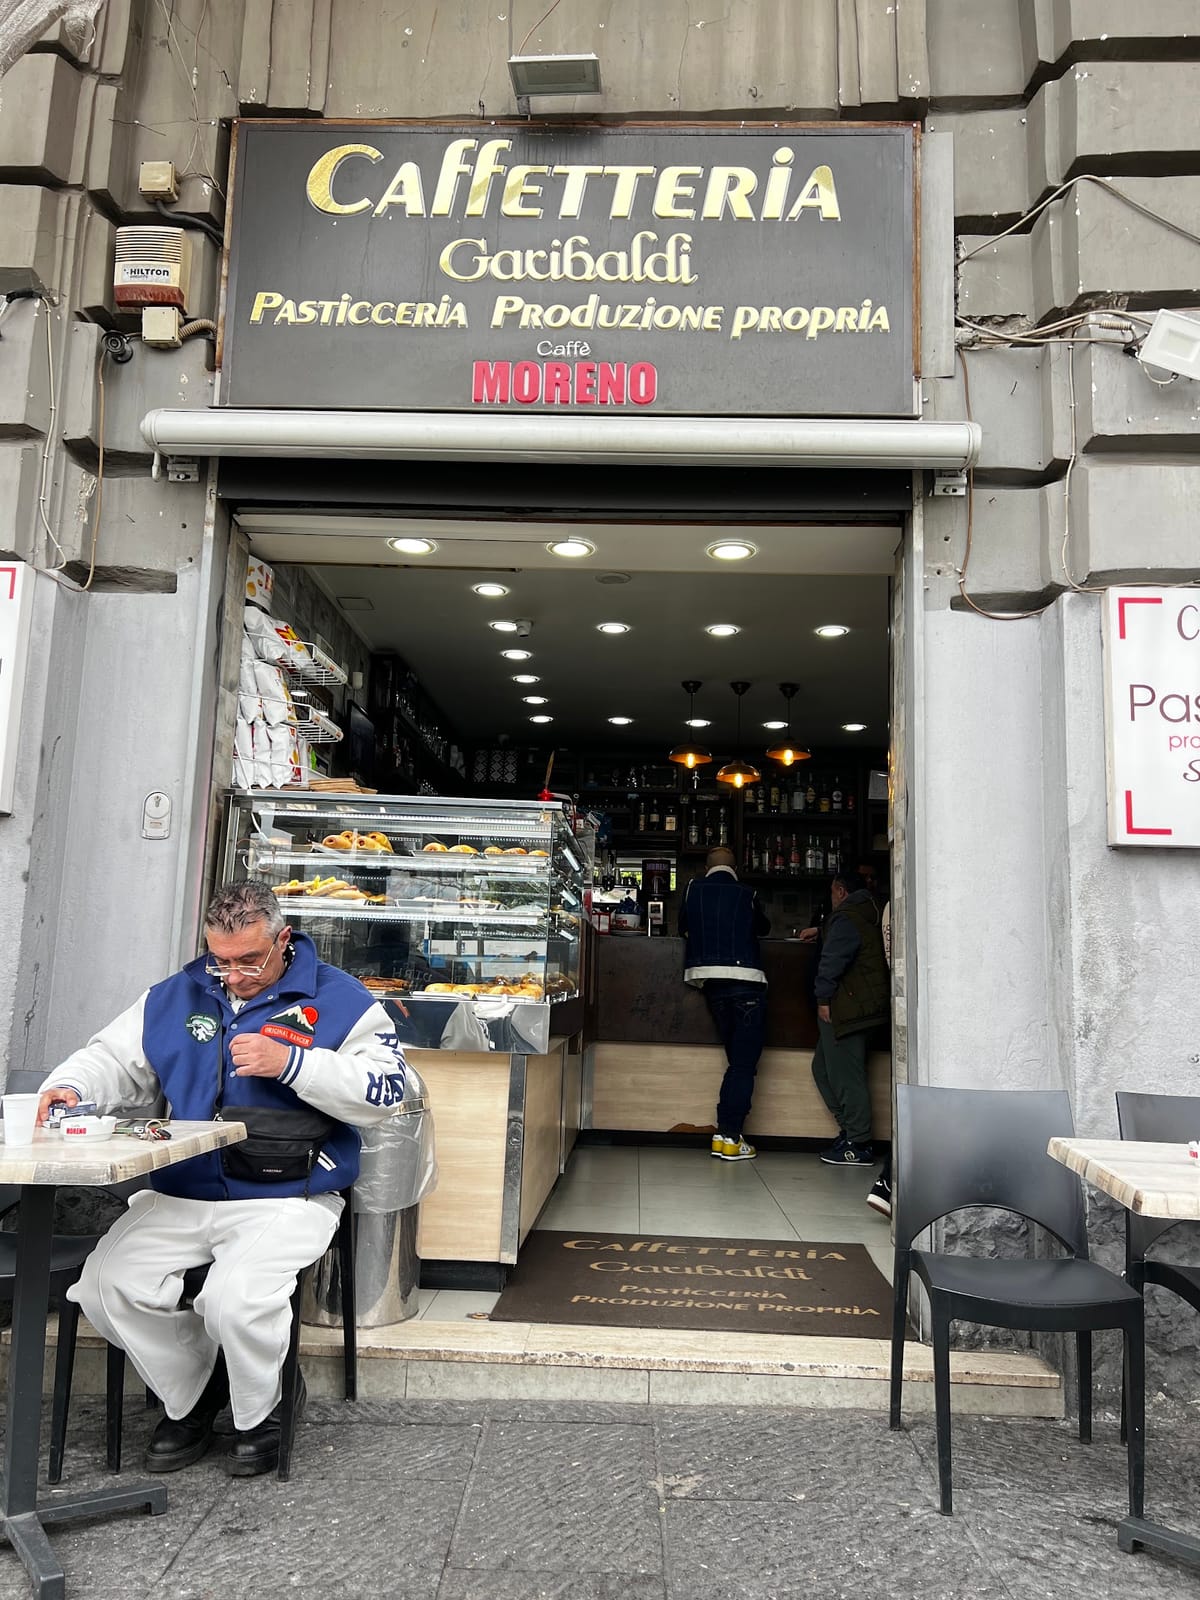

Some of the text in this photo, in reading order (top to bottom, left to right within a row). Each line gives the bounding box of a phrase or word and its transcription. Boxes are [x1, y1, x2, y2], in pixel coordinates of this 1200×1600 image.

[439, 231, 698, 285] Garibaldi
[536, 340, 592, 357] Caffè
[472, 360, 658, 405] MORENO
[590, 1261, 813, 1280] Garibaldi
